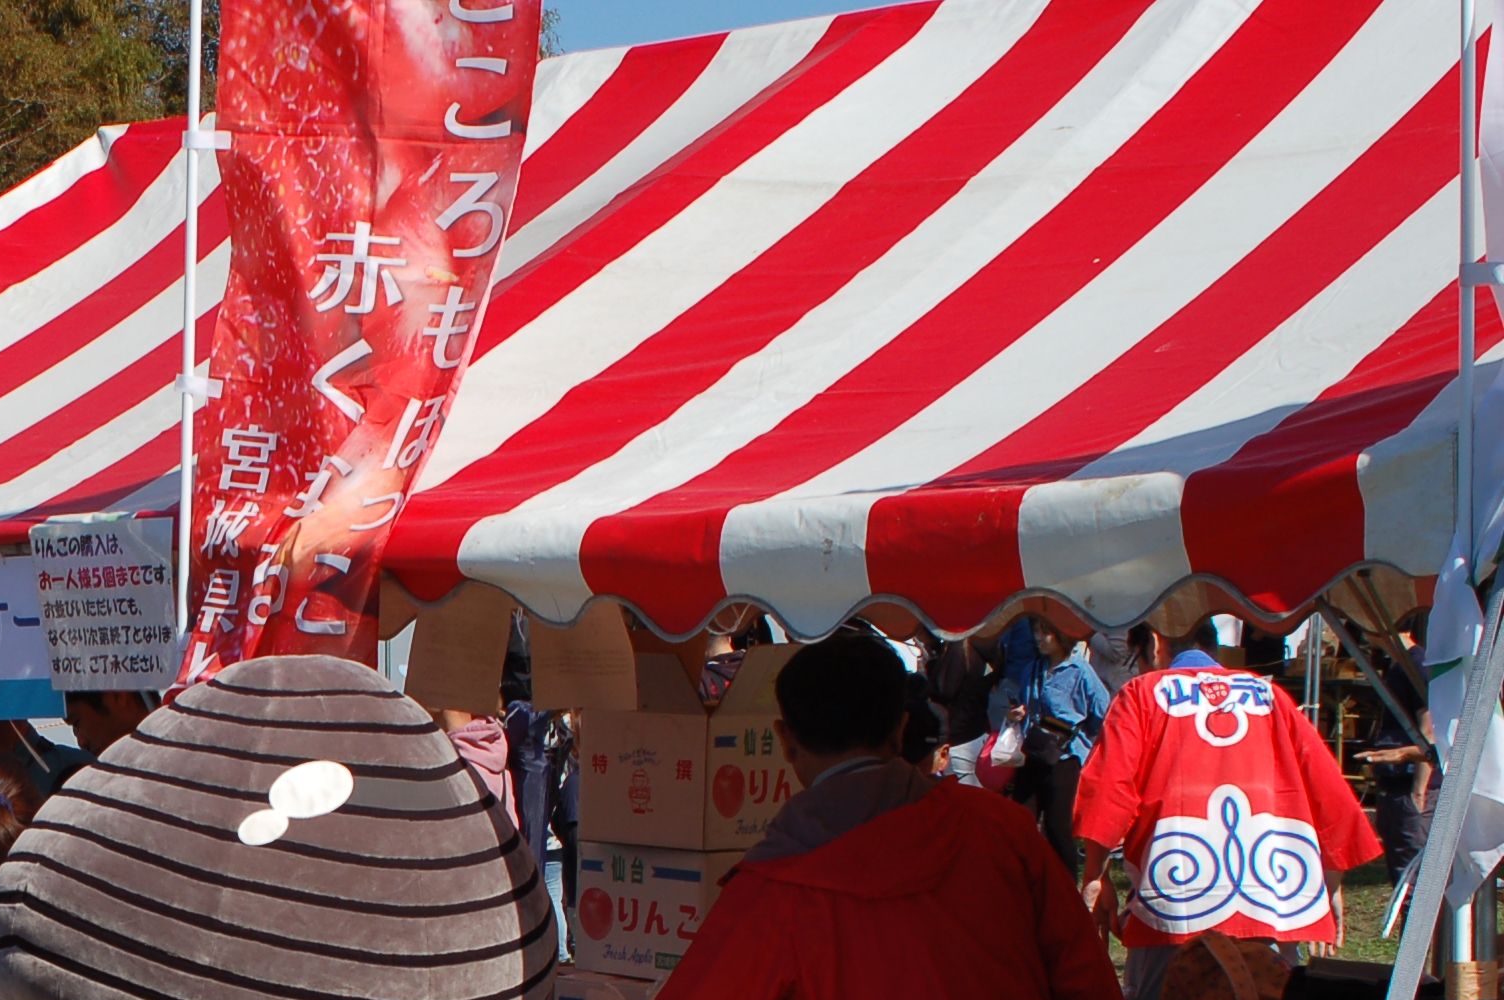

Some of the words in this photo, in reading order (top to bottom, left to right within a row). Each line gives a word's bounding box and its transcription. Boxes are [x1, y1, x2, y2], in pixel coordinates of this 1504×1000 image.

[295, 0, 514, 635] ころもほっこ
[34, 533, 124, 559] りんごの購入は、
[743, 727, 774, 757] 仙台
[749, 767, 793, 805] りん
[611, 854, 645, 885] 仙台
[617, 896, 700, 940] りんご
